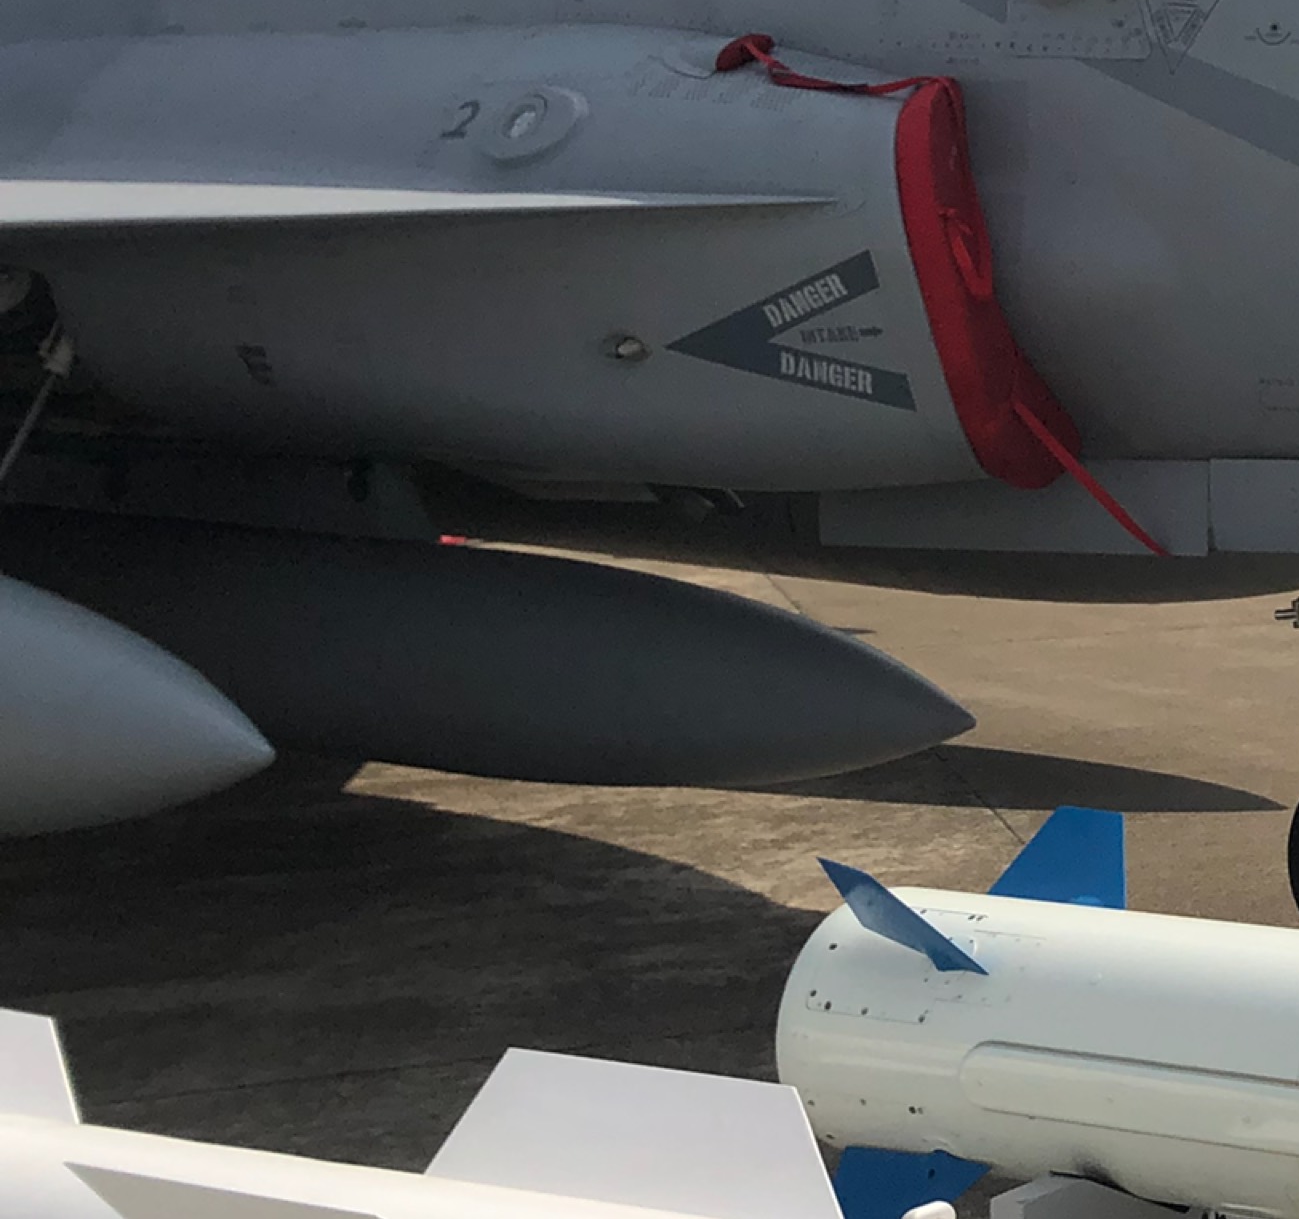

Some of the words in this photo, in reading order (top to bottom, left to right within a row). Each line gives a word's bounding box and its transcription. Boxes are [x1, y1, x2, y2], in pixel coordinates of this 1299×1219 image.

[440, 99, 481, 140] 2
[762, 273, 849, 328] DANGER
[780, 351, 873, 395] DANGER
